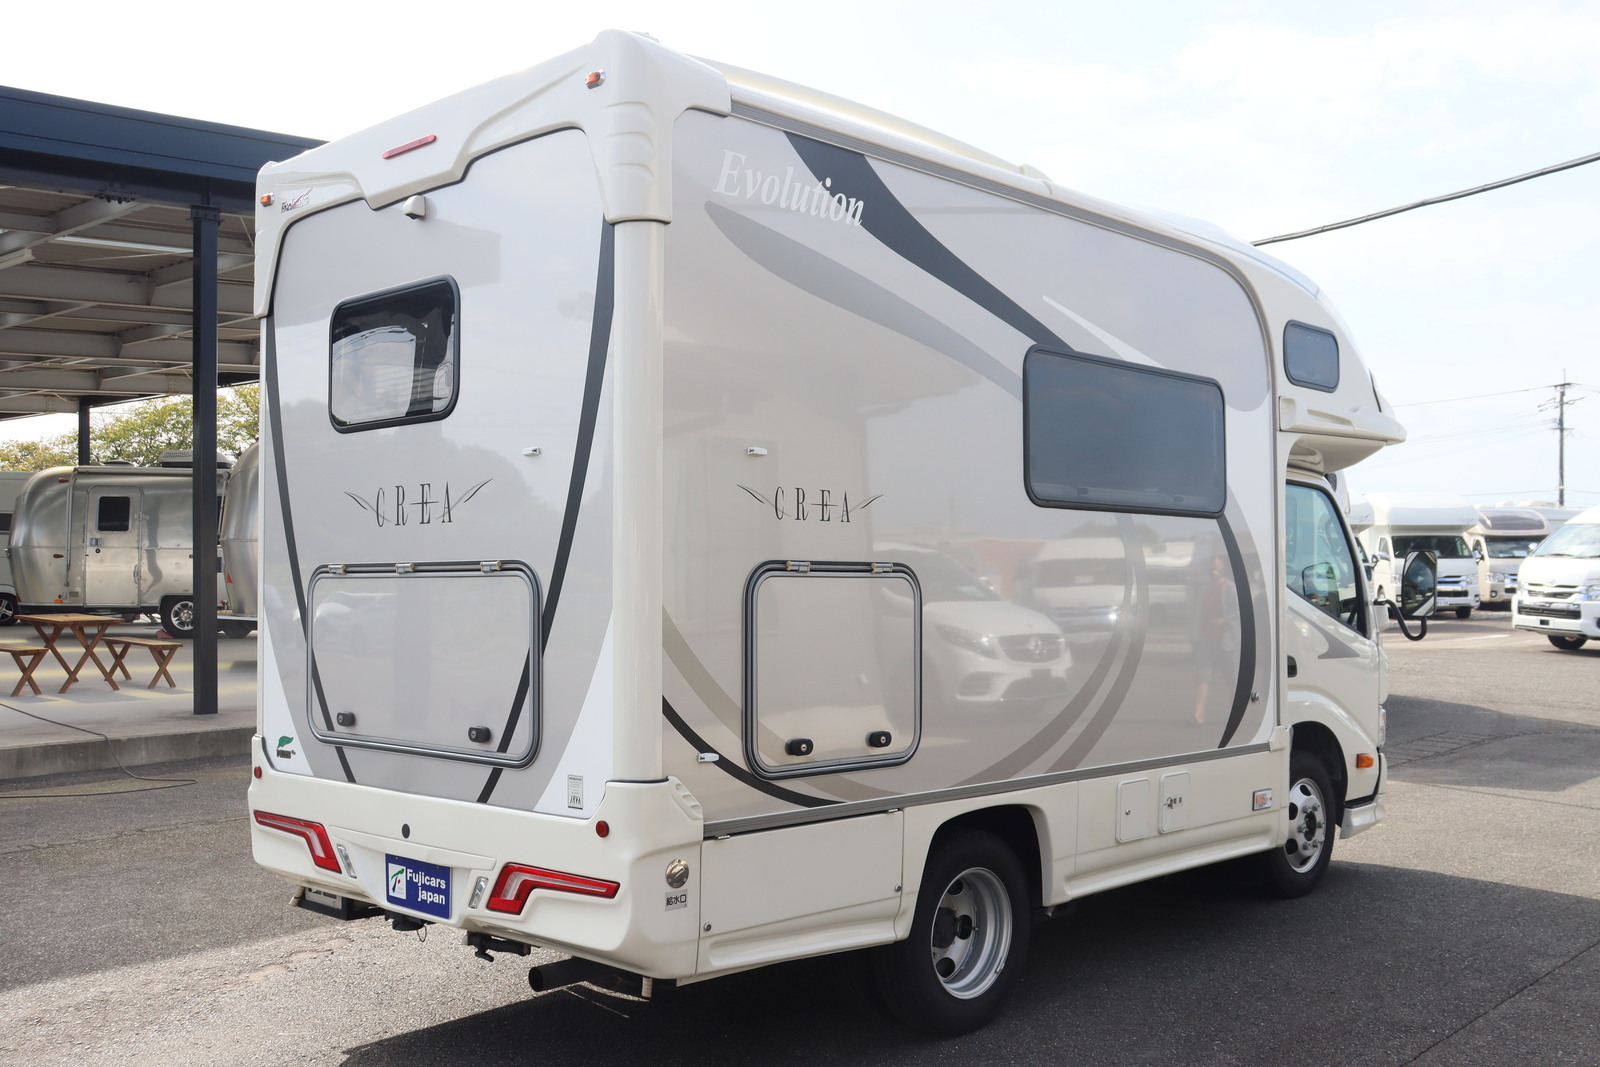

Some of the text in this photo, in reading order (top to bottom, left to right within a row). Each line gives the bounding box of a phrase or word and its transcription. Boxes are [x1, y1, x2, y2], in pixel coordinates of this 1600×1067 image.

[712, 149, 864, 227] Evolution
[376, 481, 453, 527] CREA
[774, 486, 851, 523] CREA
[406, 868, 446, 889] Fujicars
[417, 886, 446, 905] japan
[666, 894, 687, 906] 給水口
